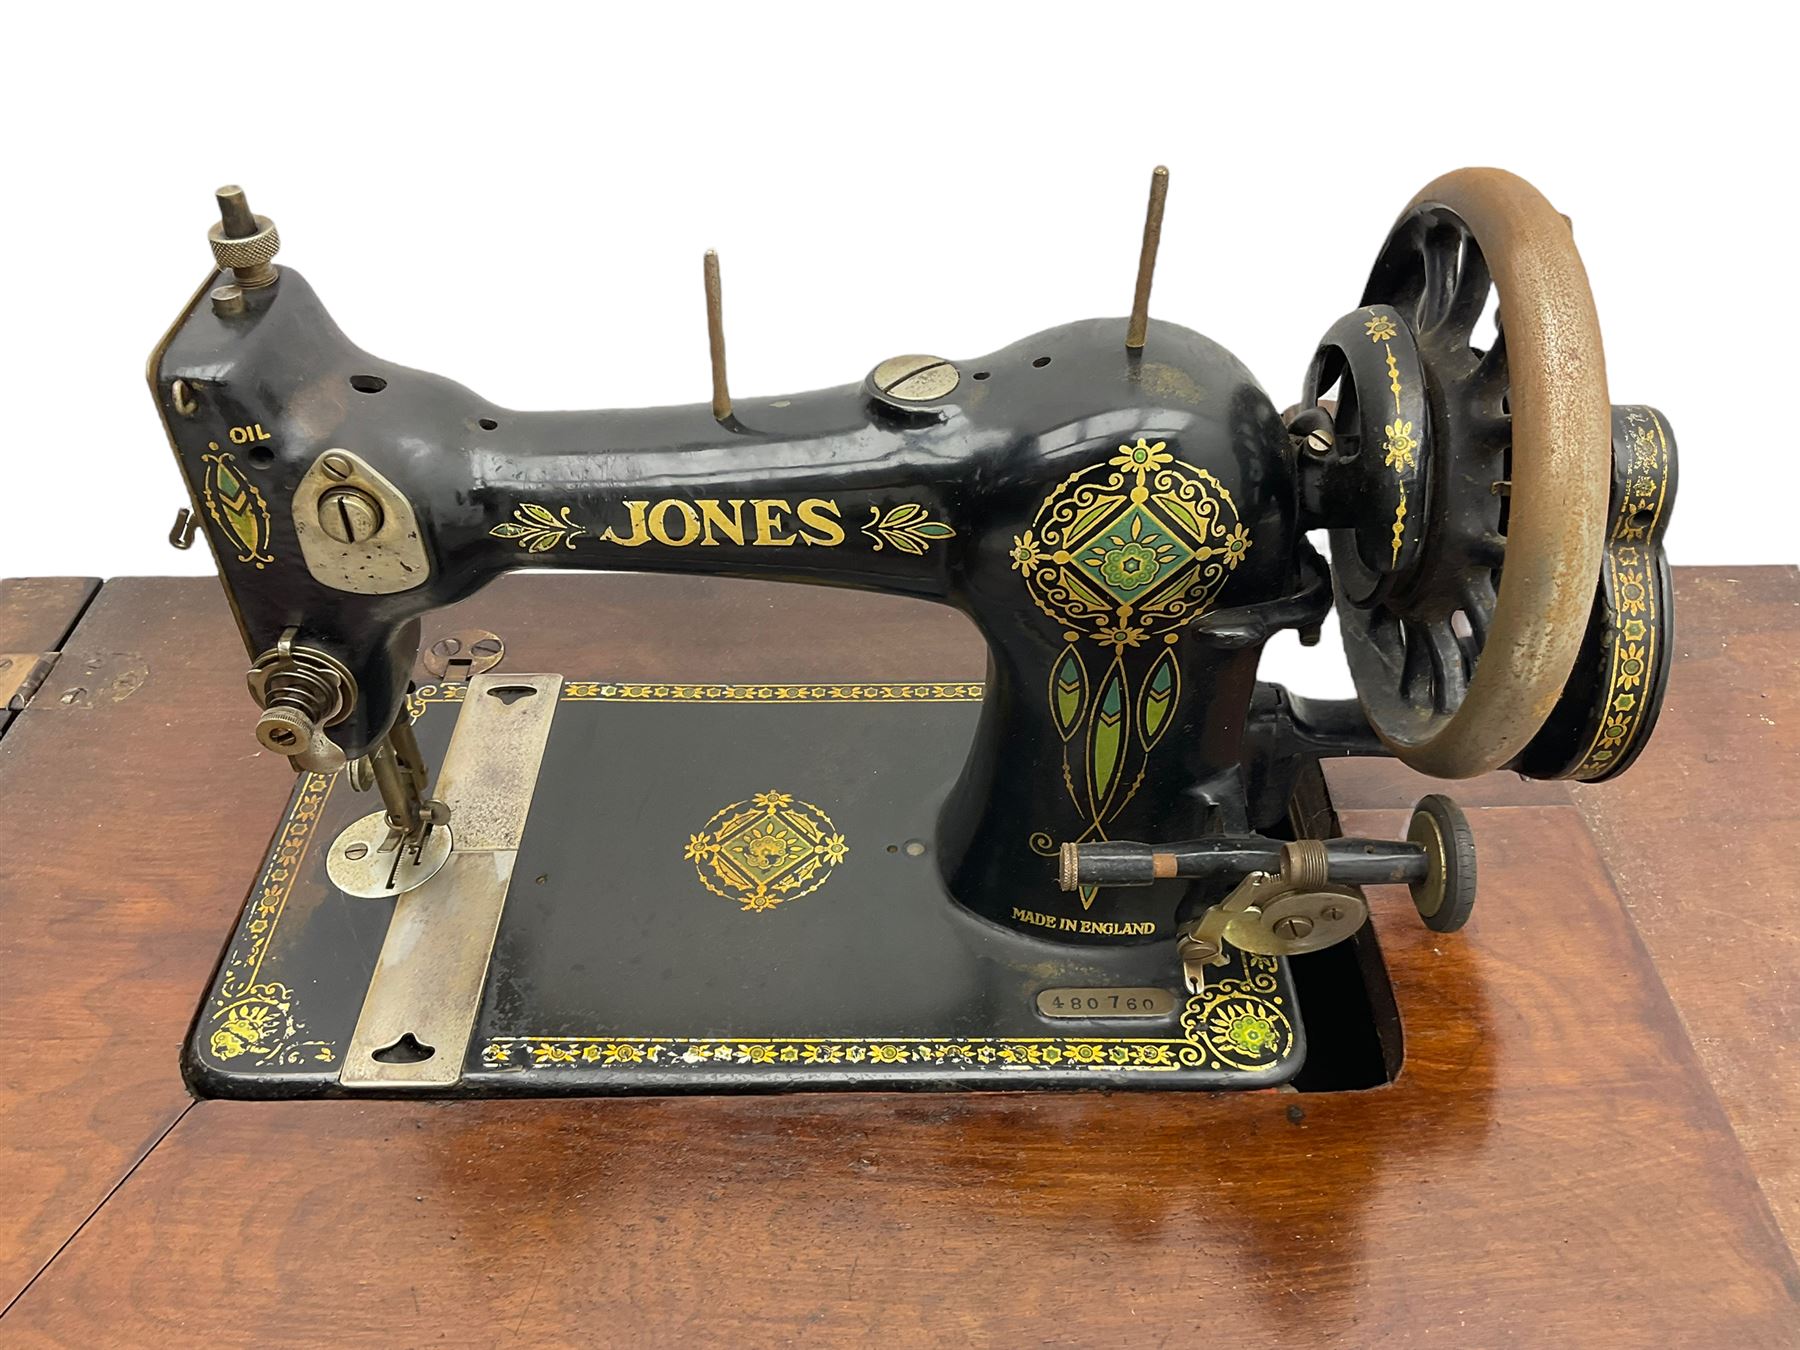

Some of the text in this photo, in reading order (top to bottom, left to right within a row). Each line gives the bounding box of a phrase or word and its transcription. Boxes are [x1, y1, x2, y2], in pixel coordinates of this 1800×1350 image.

[230, 424, 271, 444] OIL
[600, 499, 845, 547] JONES
[1011, 907, 1156, 935] MADE IN ENGLAND
